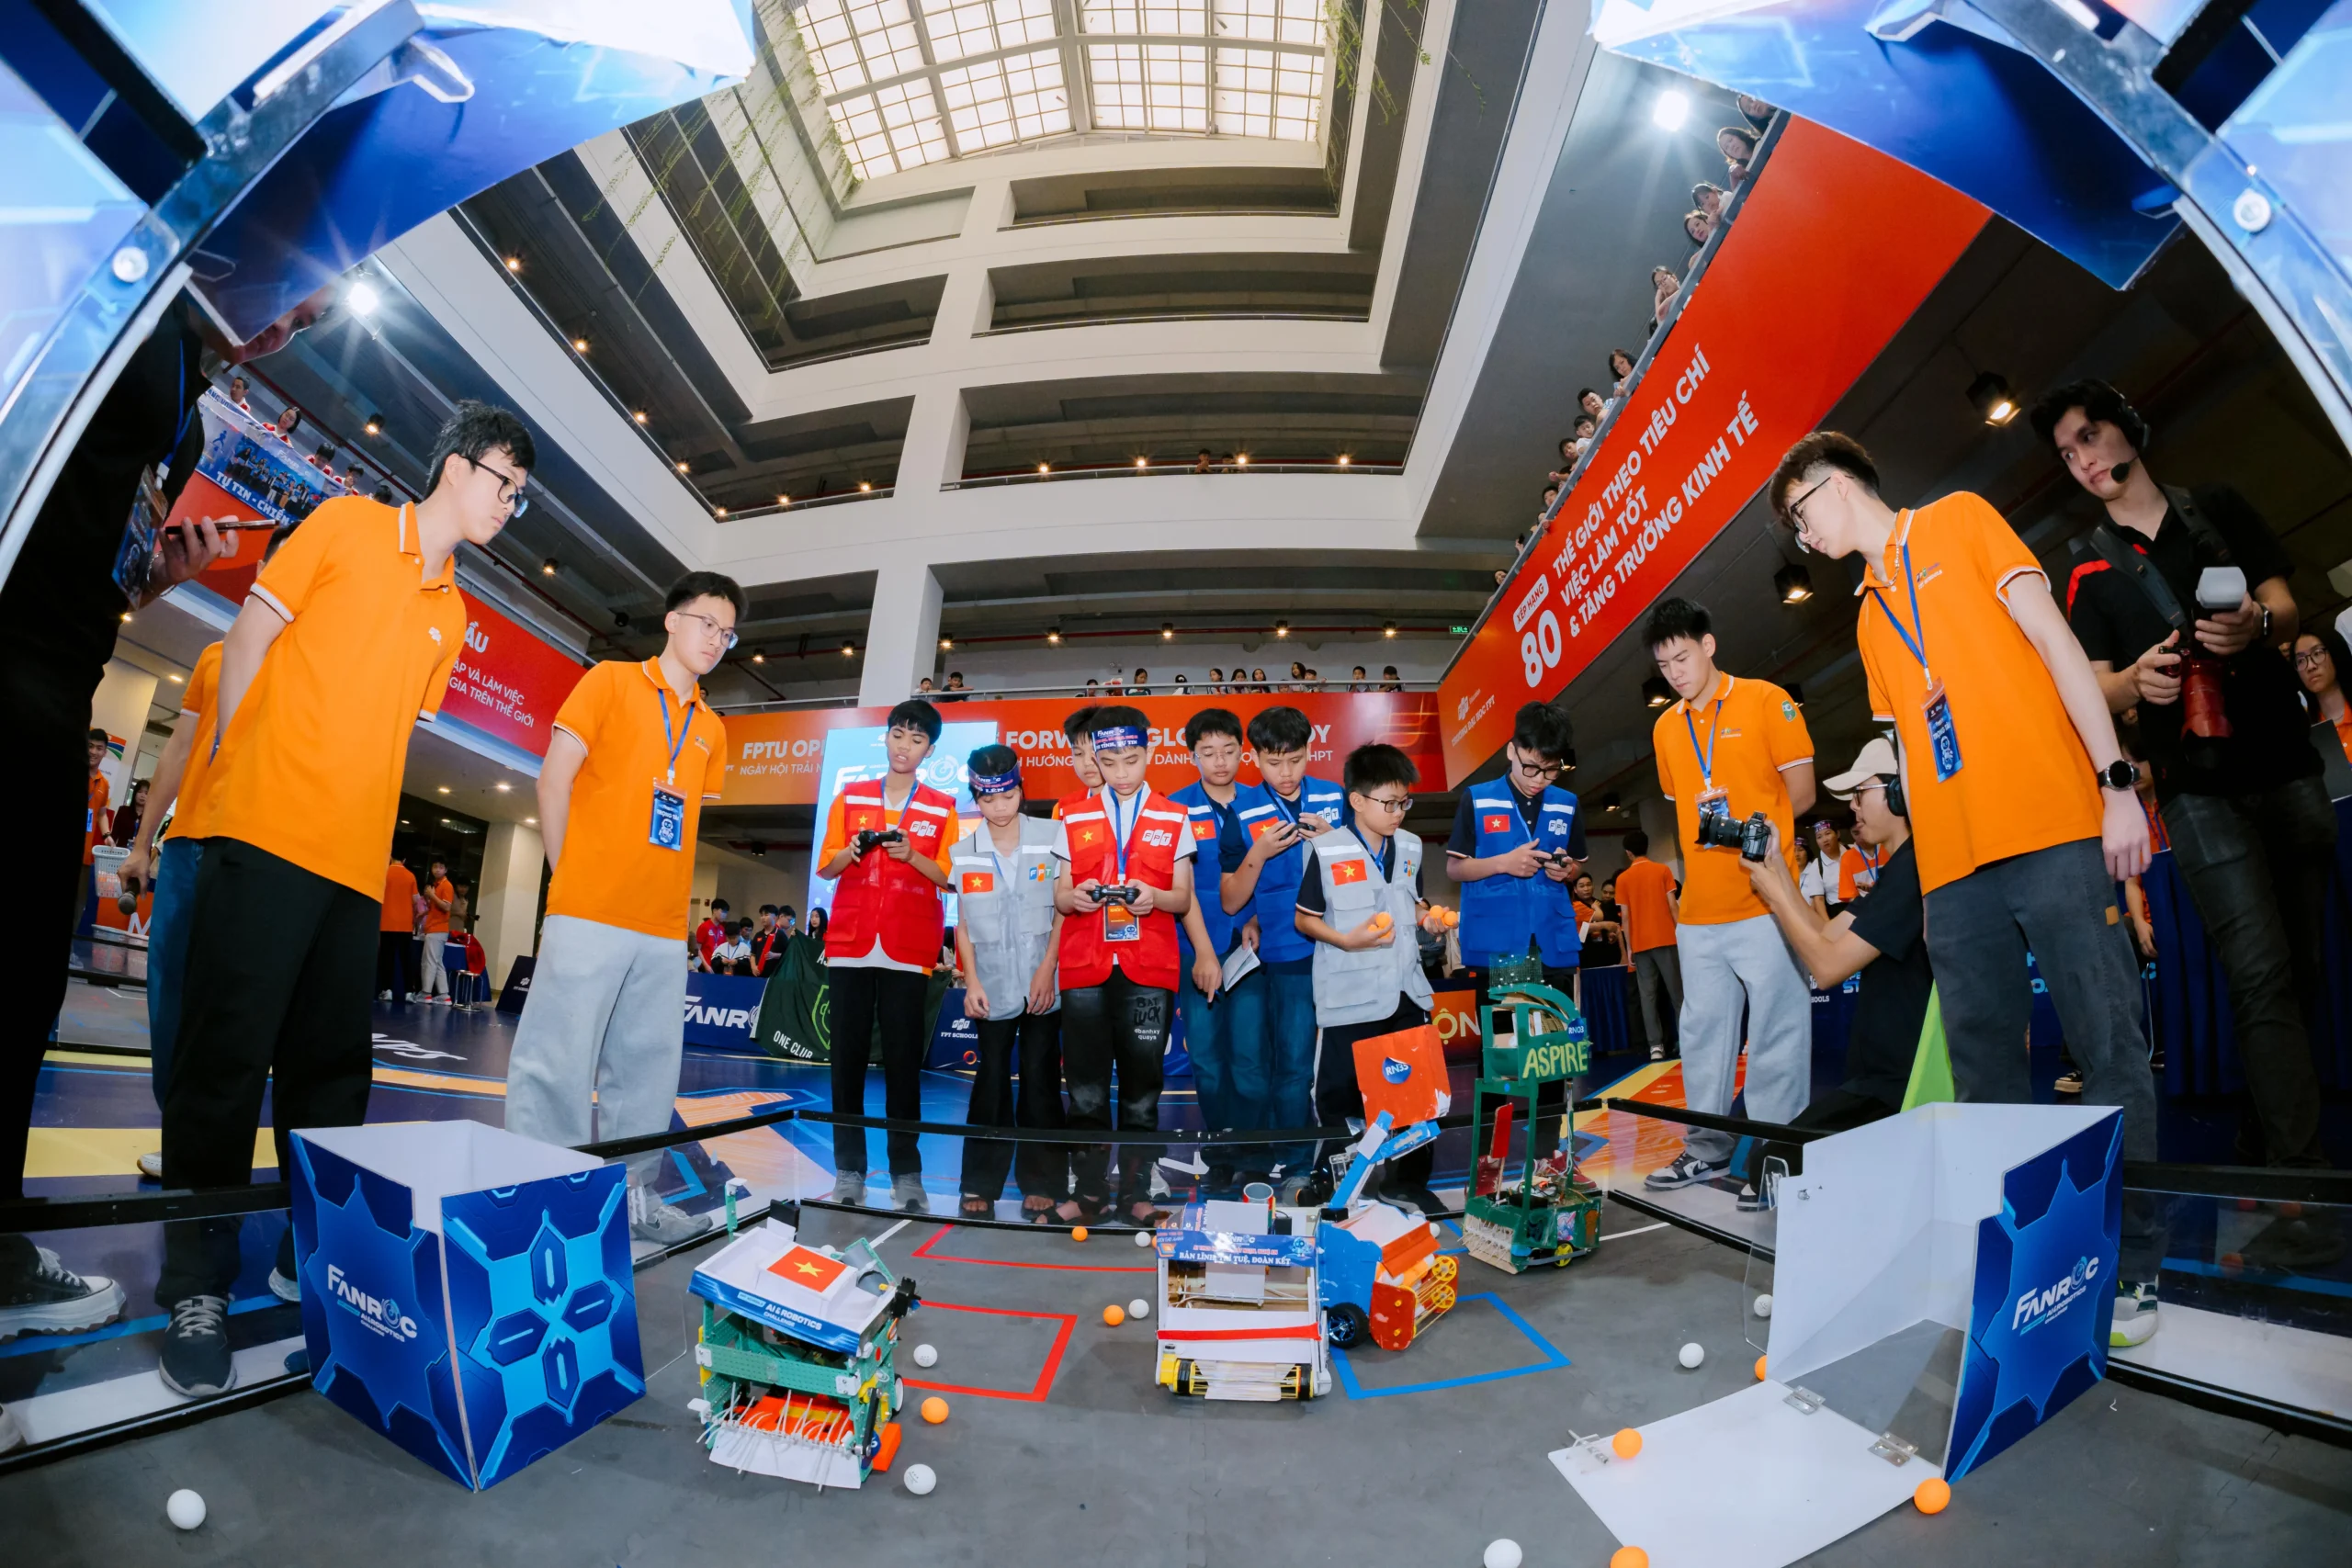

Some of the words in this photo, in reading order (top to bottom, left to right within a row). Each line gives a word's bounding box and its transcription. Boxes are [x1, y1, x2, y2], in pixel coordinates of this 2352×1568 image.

[1553, 531, 1577, 579] THẾ
[1575, 502, 1605, 548] GIỚI
[1602, 450, 1642, 509] THEO
[1639, 398, 1677, 456] TIÊU
[1675, 343, 1711, 404] CHÍ
[232, 481, 252, 502] TIN
[1570, 615, 1580, 637] &
[1578, 574, 1615, 625] TĂNG
[1614, 496, 1683, 583] TRƯỞNG
[1681, 437, 1732, 506] KINH
[1726, 389, 1759, 446] TẾ
[1560, 563, 1590, 606] VIỆC
[1589, 525, 1620, 574] LÀM
[1617, 485, 1649, 536] TỐT
[1516, 606, 1527, 624] XẾP
[1527, 582, 1544, 611] HẠNG
[465, 621, 489, 653] ẦU
[1521, 610, 1562, 688] 80
[453, 658, 467, 674] ẬP
[468, 667, 481, 682] VÀ
[481, 675, 503, 694] LÀM
[503, 686, 525, 705] VIỆC
[449, 677, 467, 694] GIA
[469, 686, 494, 707] TRÊN
[514, 710, 534, 728] GIỚI
[1005, 731, 1073, 750] FORW
[1097, 728, 1125, 737] FANRC
[742, 740, 787, 760] FPTU
[1026, 753, 1074, 767] HƯỚNG
[1155, 749, 1193, 765] DÀNH
[1307, 750, 1333, 762] HPT
[740, 763, 767, 775] NGÀY
[770, 761, 788, 777] HỘI
[791, 761, 813, 773] TRẢI
[910, 820, 937, 837] FPT
[1548, 818, 1567, 836] FPT
[1142, 829, 1172, 847] FPT
[1029, 863, 1052, 882] FPT
[1811, 995, 1829, 1003] HOOLS
[684, 996, 758, 1030] FANR
[1432, 1008, 1481, 1045] ỘN
[1568, 1025, 1585, 1035] RN03
[773, 1030, 791, 1050] ONE
[1522, 1041, 1589, 1079] ASPIRE
[1385, 1064, 1408, 1077] RN35
[1180, 1250, 1195, 1259] BẢN
[1252, 1255, 1274, 1265] ĐOÀN
[1275, 1255, 1291, 1265] KẾT
[328, 1263, 417, 1338] FANROC
[2012, 1257, 2099, 1330] FANROC
[763, 1311, 796, 1328] CHALLENGE
[765, 1303, 775, 1312] AI
[780, 1309, 822, 1331] ROBOTICS
